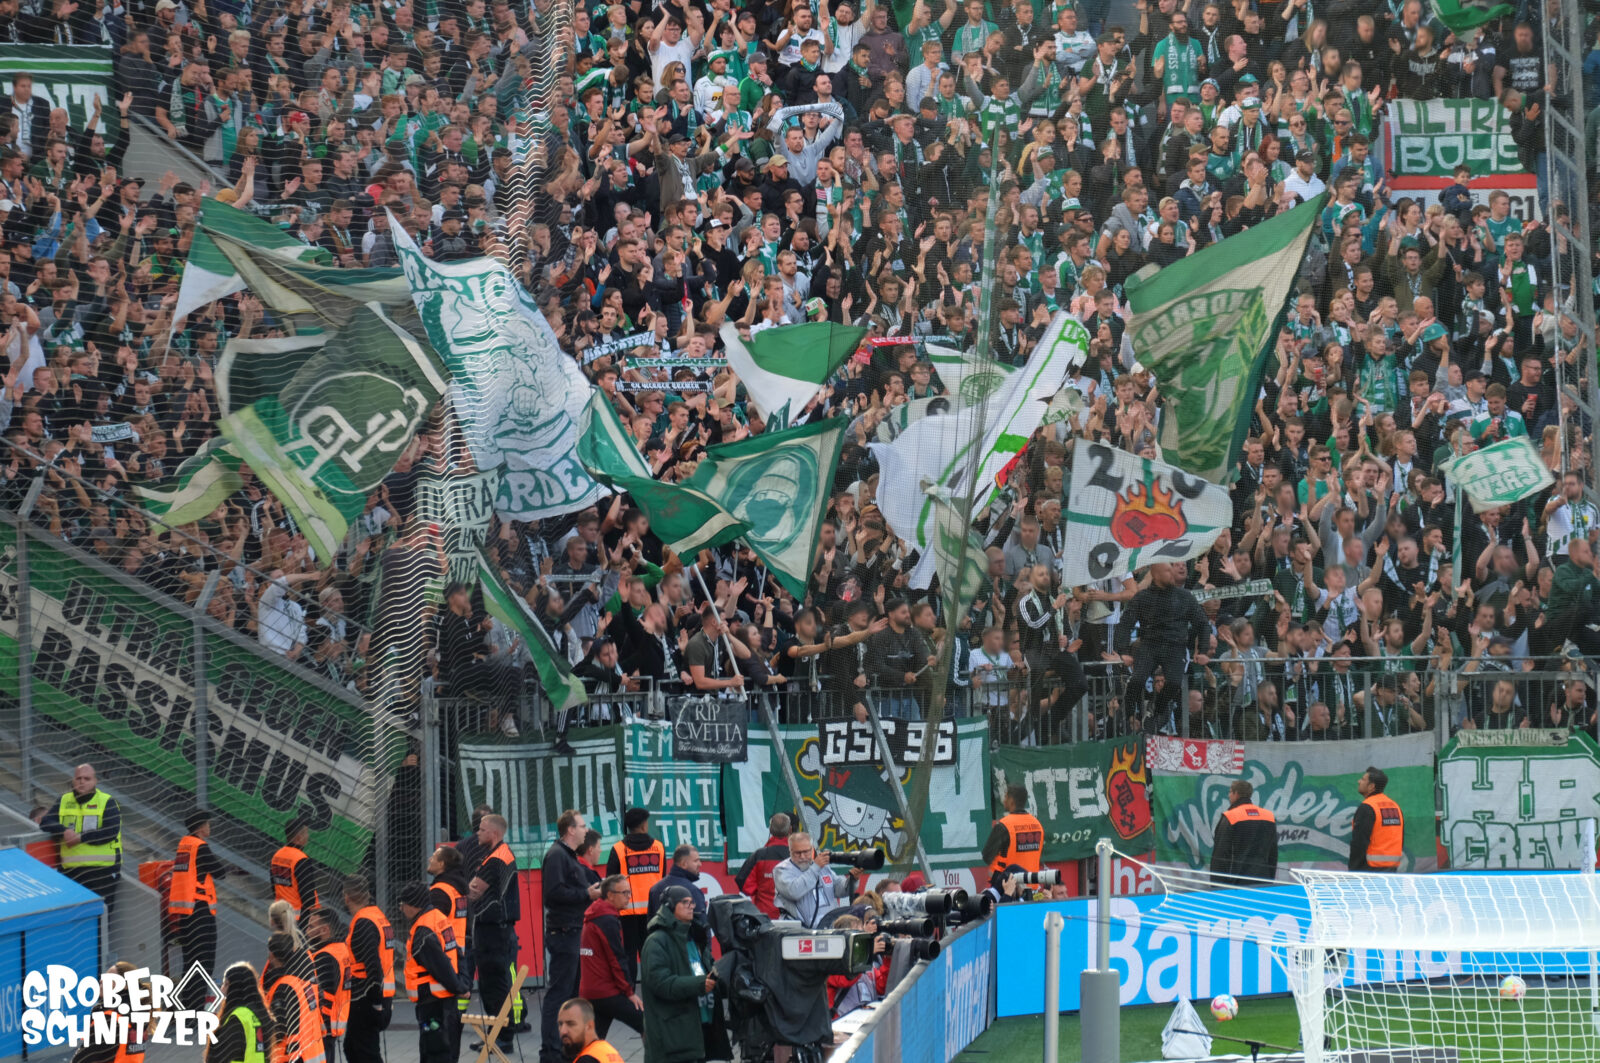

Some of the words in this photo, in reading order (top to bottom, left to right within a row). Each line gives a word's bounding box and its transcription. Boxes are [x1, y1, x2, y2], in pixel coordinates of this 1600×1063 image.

[1400, 135, 1524, 172] BOYS
[61, 579, 212, 688] ULTRAS
[216, 662, 352, 761] GEGEN
[696, 703, 720, 721] RIP
[32, 626, 342, 832] RASSISMUS
[624, 729, 673, 757] SEM
[675, 722, 743, 742] CIVETTA
[1457, 729, 1548, 746] WESERSTADION
[624, 777, 718, 807] AVANTI
[655, 818, 726, 848] TRAS
[1450, 818, 1597, 869] CREW
[943, 869, 960, 886] You
